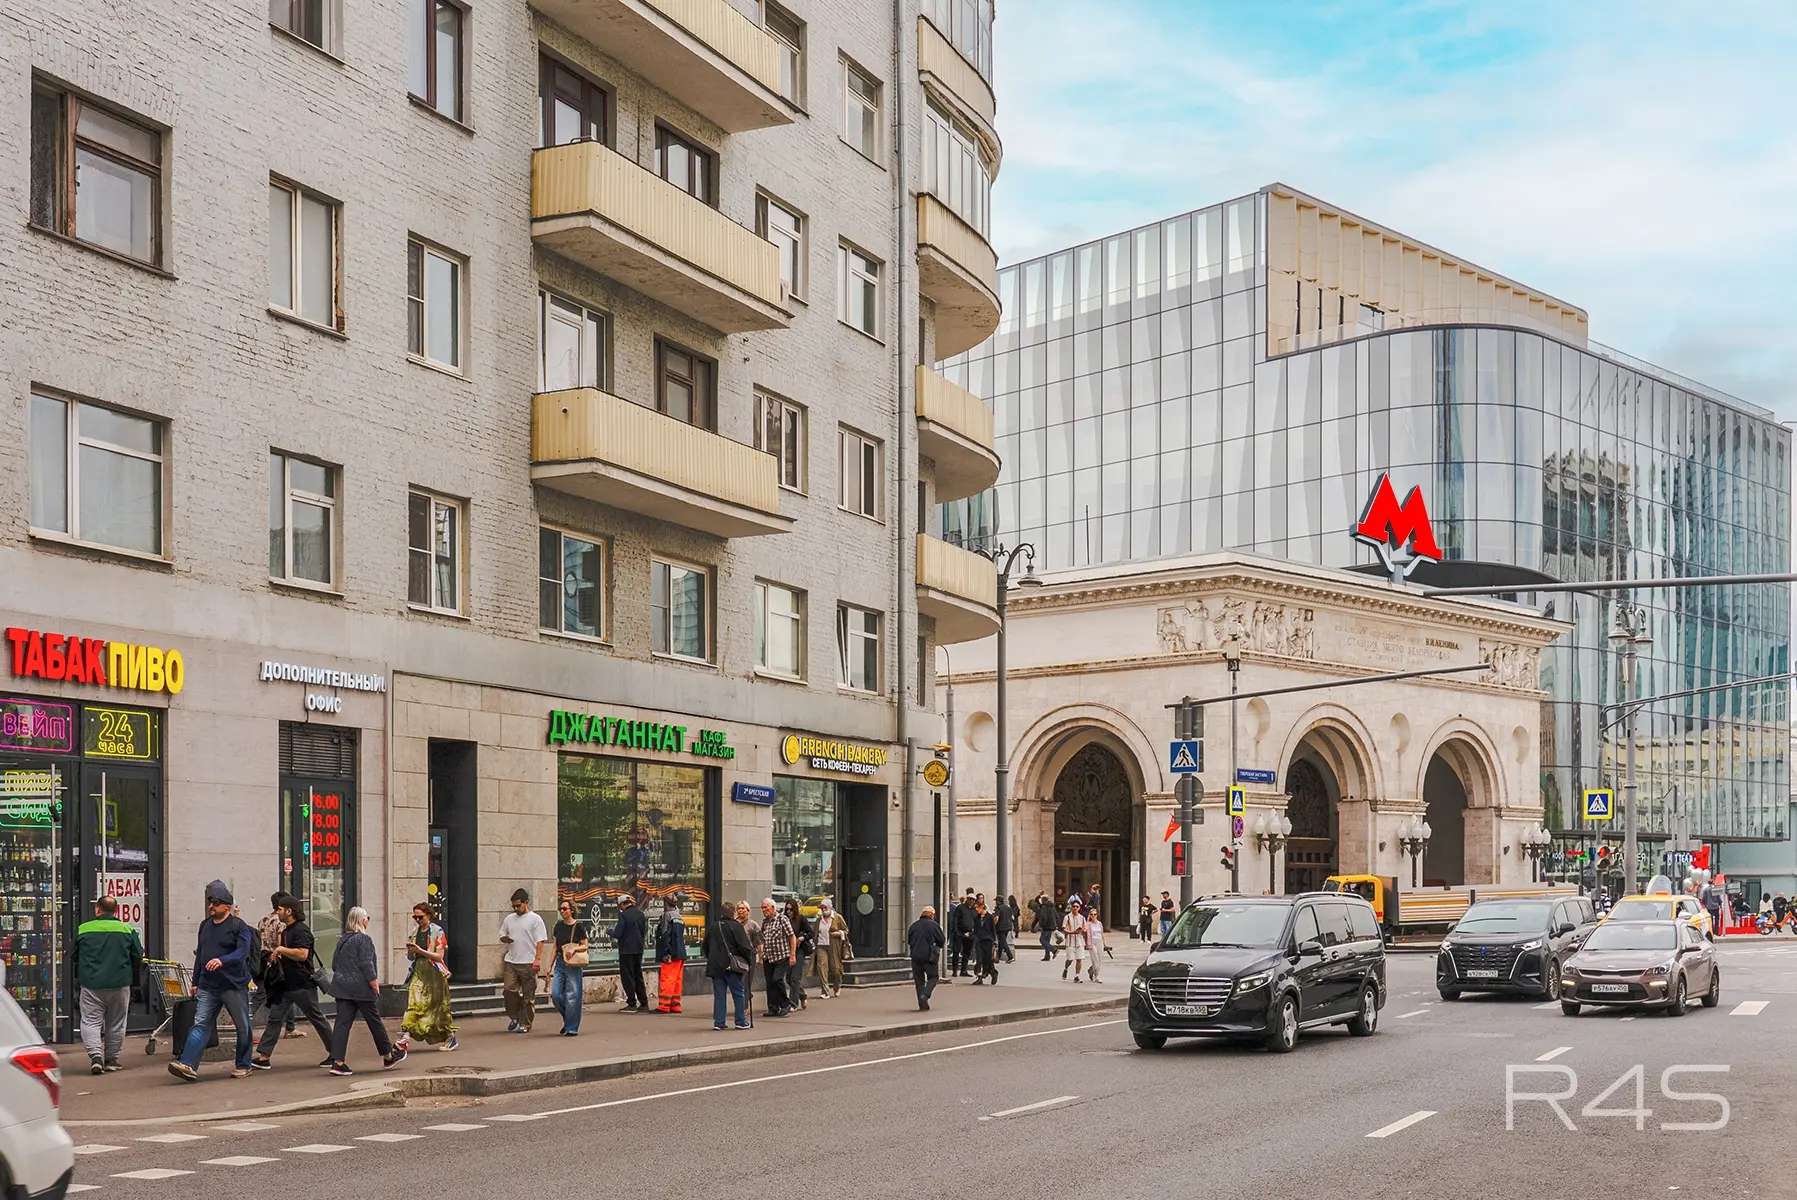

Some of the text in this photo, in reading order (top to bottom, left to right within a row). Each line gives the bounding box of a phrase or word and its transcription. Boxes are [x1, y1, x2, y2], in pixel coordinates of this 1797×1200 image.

[1350, 471, 1442, 560] М
[6, 628, 184, 694] ТАБАК ПИВО
[260, 661, 387, 692] ДОПОЛНИТЕЛЬНЫЙ
[306, 693, 341, 713] ОФИС
[3, 709, 66, 740] ВЕЙП
[99, 712, 134, 742] 24
[549, 709, 687, 753] ДЖАГАННАТ
[700, 729, 727, 745] КАФЕ
[692, 742, 735, 760] МАГАЗИН
[801, 737, 888, 766] FRENCH BAKERY
[812, 757, 828, 769] СЕТЬ
[117, 903, 142, 924] ИВО
